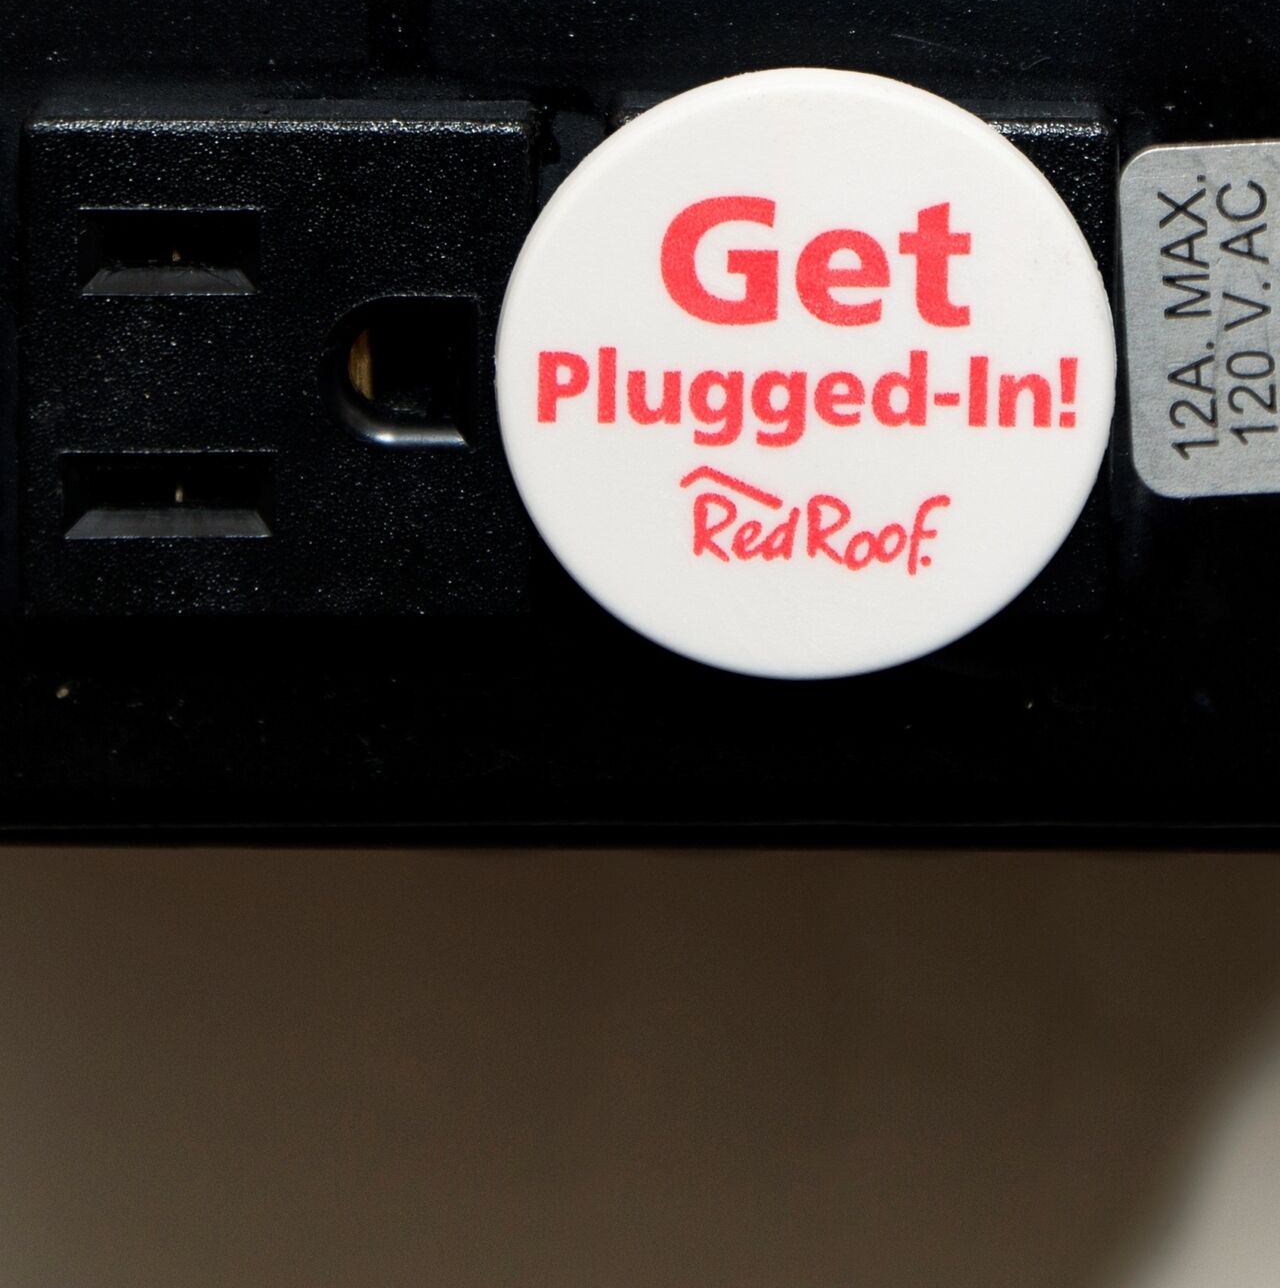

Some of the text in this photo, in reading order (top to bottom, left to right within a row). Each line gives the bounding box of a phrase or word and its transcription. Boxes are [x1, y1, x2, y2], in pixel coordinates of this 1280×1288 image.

[659, 194, 972, 329] Get
[1157, 175, 1219, 459] 12A. MAX.
[536, 345, 1079, 449] Plugged-In!
[1225, 350, 1278, 444] 120
